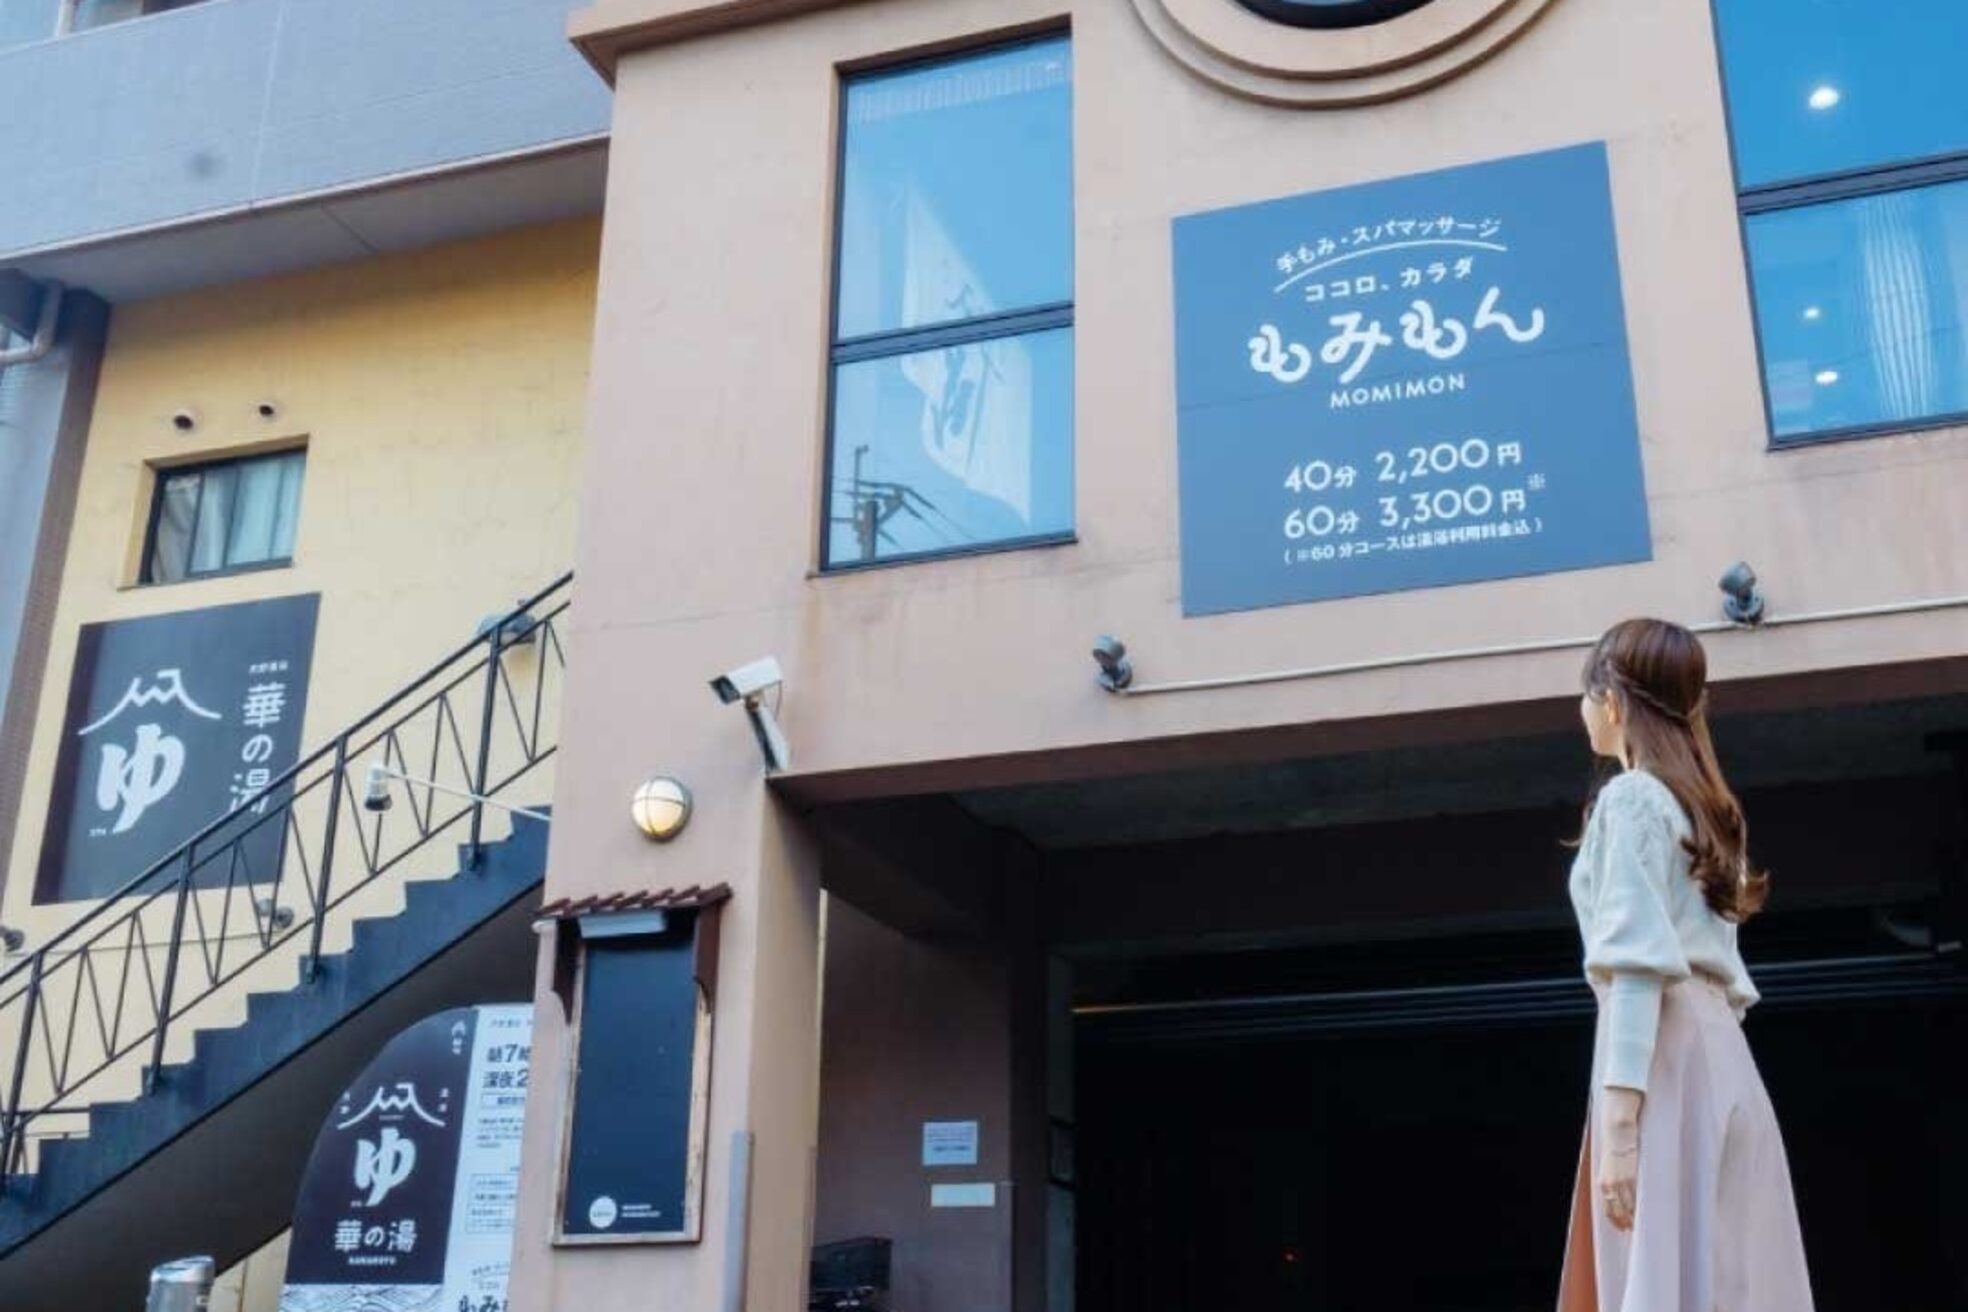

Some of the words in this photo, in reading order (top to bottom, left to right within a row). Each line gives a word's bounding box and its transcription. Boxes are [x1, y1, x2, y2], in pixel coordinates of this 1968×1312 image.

[1276, 216, 1501, 274] 手もみ・スパマッサージ
[1305, 256, 1473, 301] ココロ、カラダ
[1248, 286, 1545, 384] もみもん
[1329, 373, 1466, 409] MOMIMON
[1284, 459, 1357, 493] 40分
[1284, 504, 1360, 539] 60分
[96, 723, 186, 836] ゆ
[354, 1126, 417, 1207] ゆ
[334, 1218, 418, 1252] 華の湯
